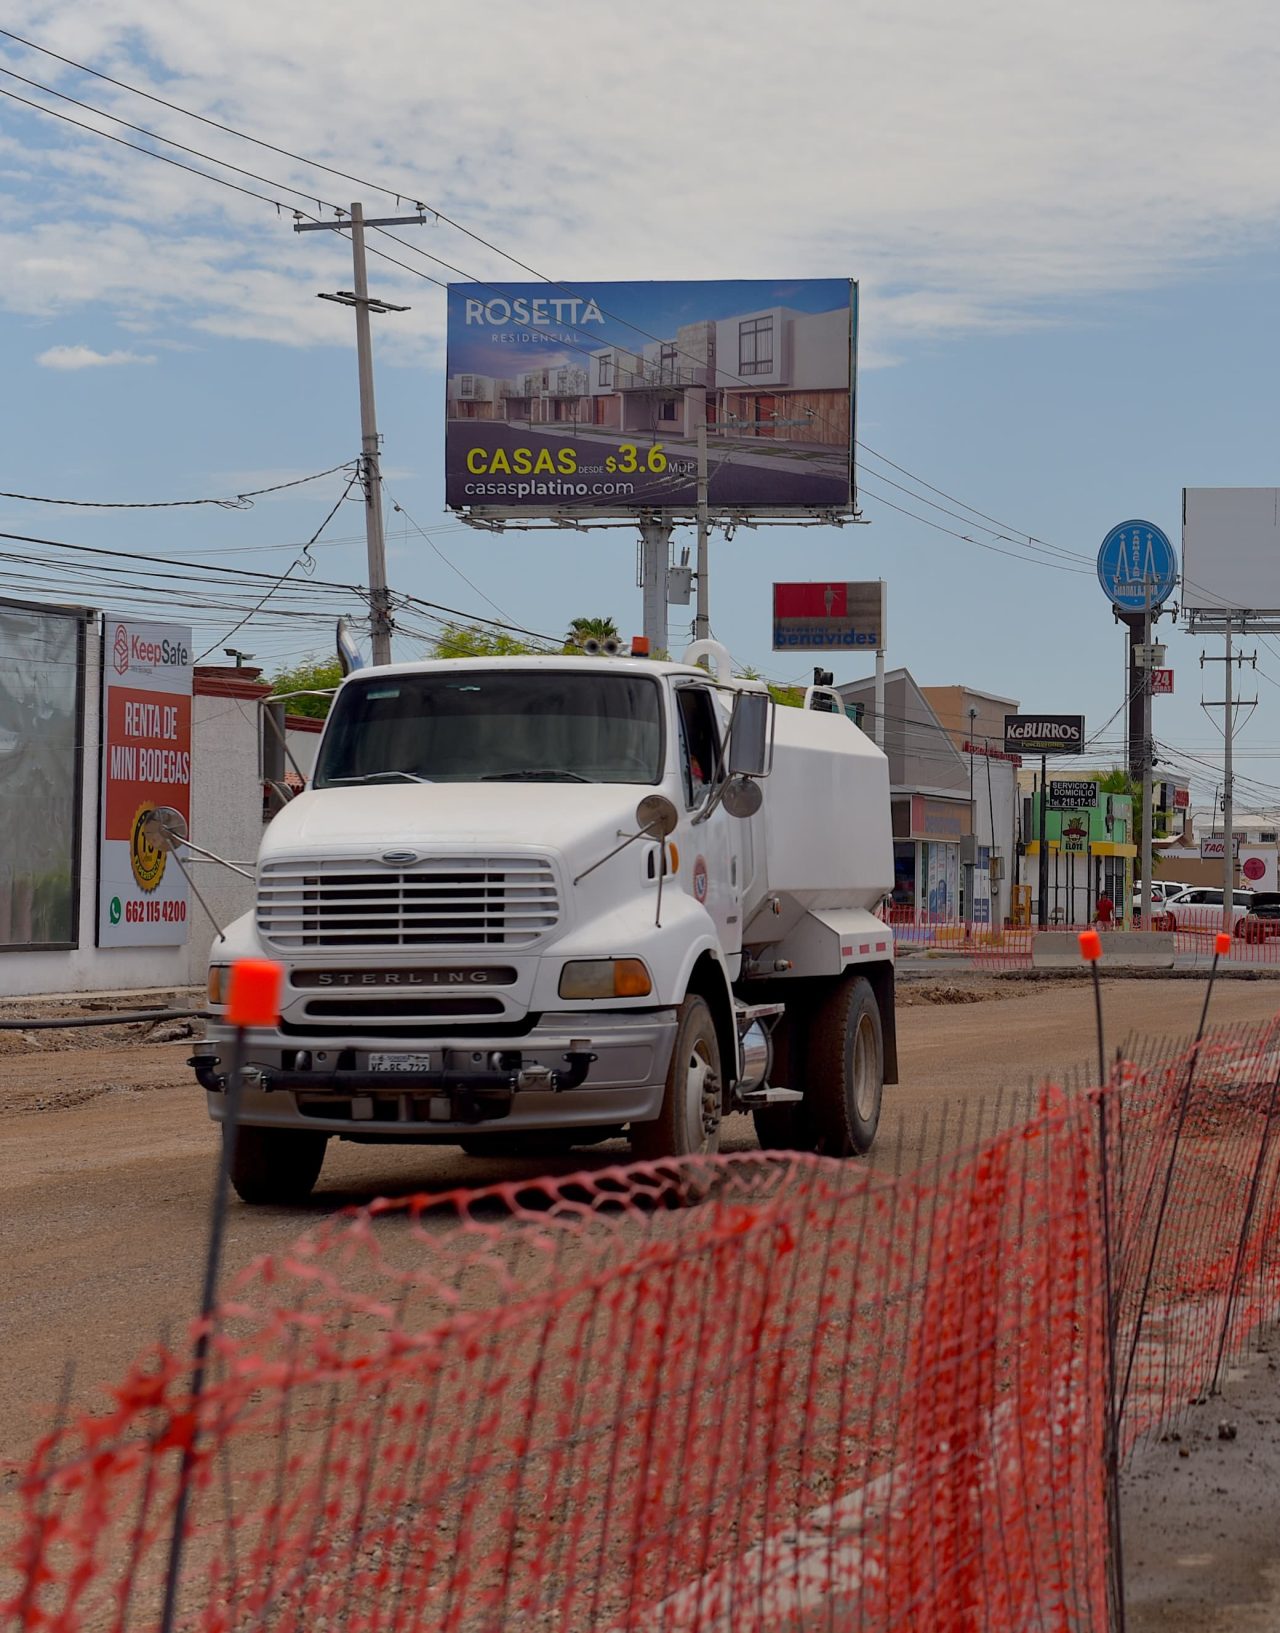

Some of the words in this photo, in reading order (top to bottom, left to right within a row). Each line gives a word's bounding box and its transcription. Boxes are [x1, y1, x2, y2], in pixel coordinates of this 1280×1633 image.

[465, 298, 606, 325] ROSETTA
[491, 333, 580, 343] RESIDENCIAL
[466, 447, 577, 475] CASAS
[578, 465, 604, 474] DESDE
[605, 443, 667, 474] $3.6
[464, 479, 635, 498] casasplatino.com
[775, 627, 877, 646] benavides
[131, 634, 189, 668] KeepSafe
[1153, 671, 1170, 686] 24
[125, 701, 161, 738] RENTA
[162, 706, 178, 740] DE
[1006, 722, 1080, 739] KeBURROS
[110, 745, 138, 781] MINI
[139, 750, 190, 785] BODEGAS
[1052, 782, 1089, 790] SERVICIO
[1089, 782, 1096, 790] A
[1053, 789, 1094, 797] DOMICILIO
[1065, 842, 1083, 850] ELOTE
[125, 900, 145, 923] 662
[146, 901, 160, 922] 115
[161, 900, 187, 923] 4200
[318, 970, 489, 985] STERLING
